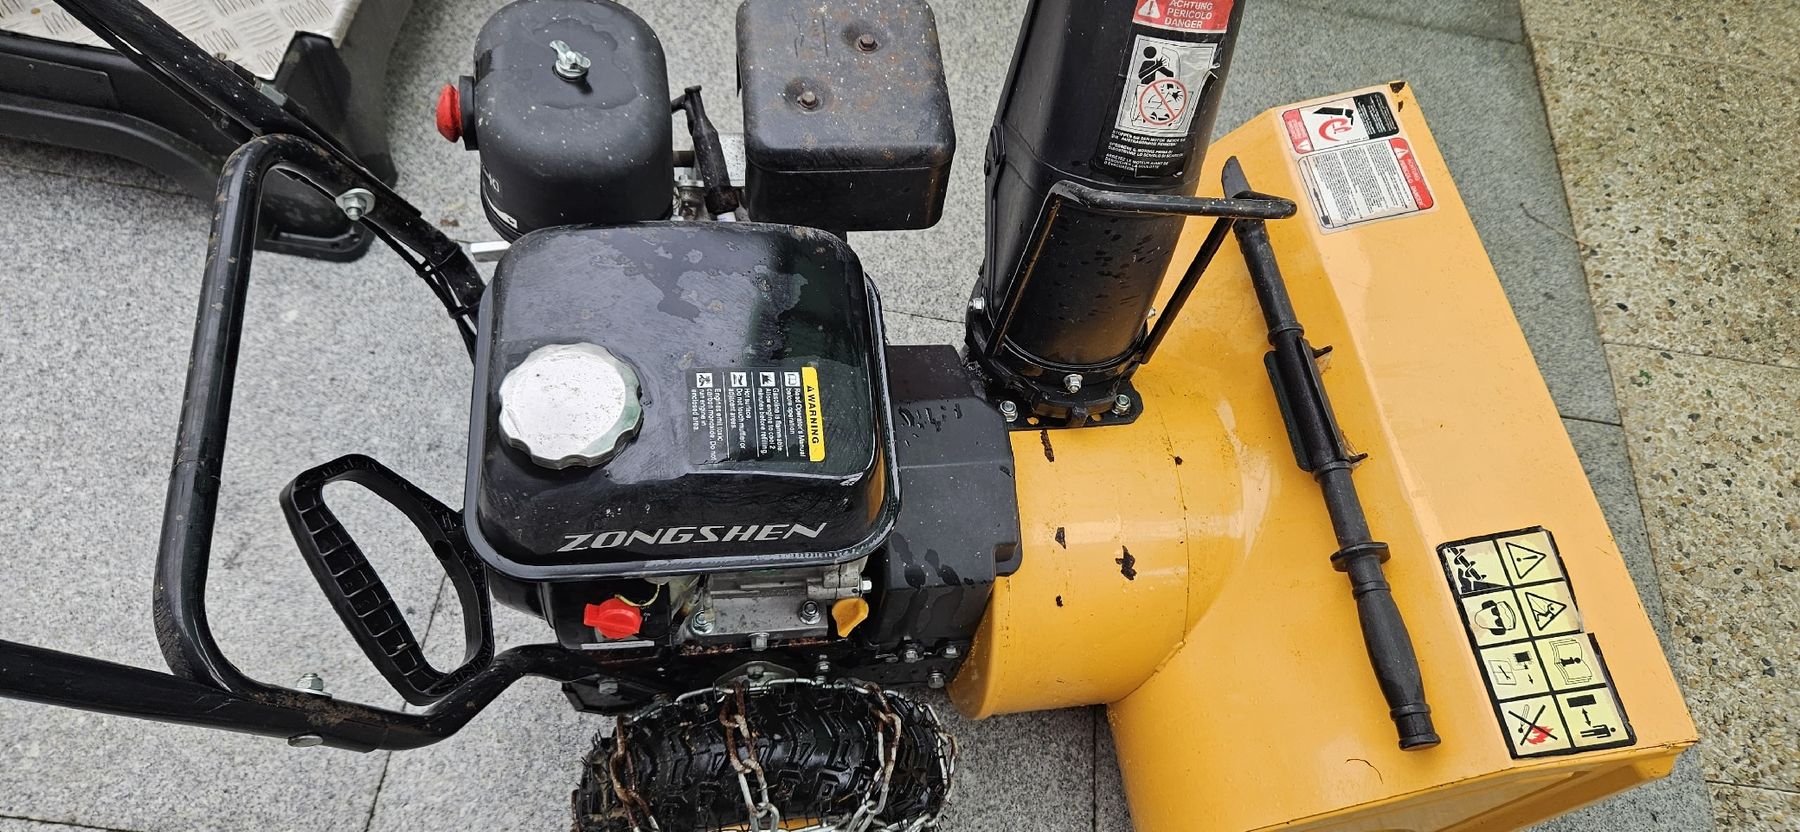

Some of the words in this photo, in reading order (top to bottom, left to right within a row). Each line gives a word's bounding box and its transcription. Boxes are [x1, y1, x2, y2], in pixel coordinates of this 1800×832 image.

[1166, 7, 1212, 20] PERICOLO
[1169, 0, 1213, 10] ACHTUNG
[1164, 16, 1203, 28] DANGER
[691, 389, 699, 416] enclosed
[706, 388, 714, 410] carbon
[714, 388, 722, 412] Engines
[727, 388, 736, 412] adjacent
[736, 388, 743, 396] Do
[785, 388, 794, 406] before
[698, 400, 707, 420] engine
[786, 406, 795, 434] operation
[795, 403, 804, 434] Operator's
[807, 394, 819, 444] WARNING
[709, 441, 716, 450] Do
[798, 435, 806, 457] Manual
[556, 522, 827, 552] ZONGSHEN
